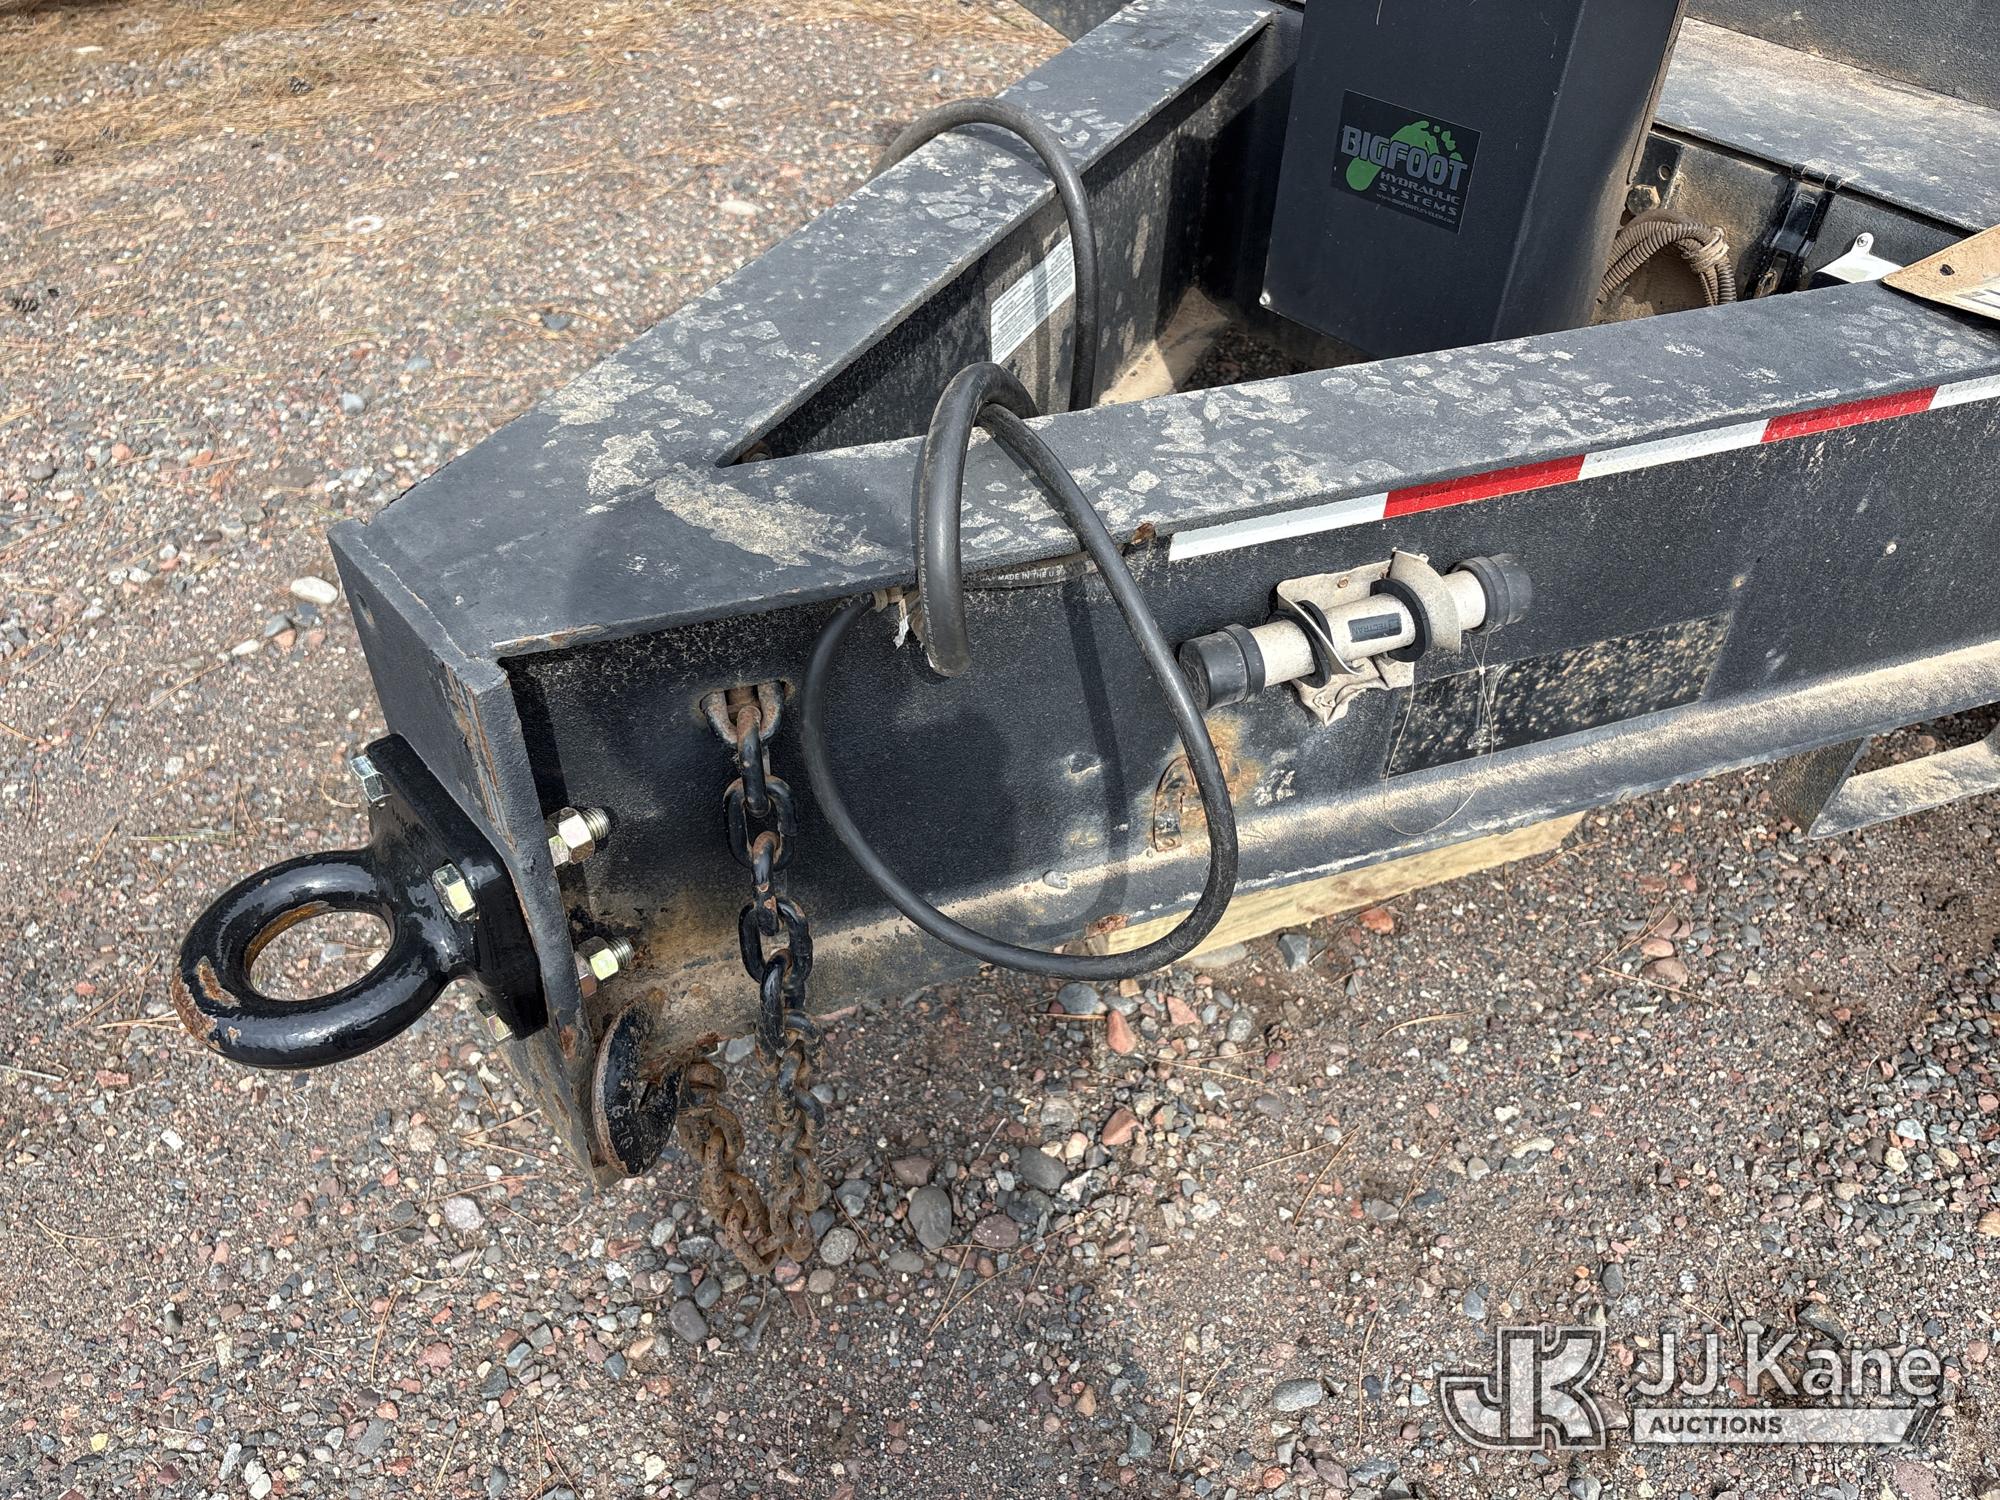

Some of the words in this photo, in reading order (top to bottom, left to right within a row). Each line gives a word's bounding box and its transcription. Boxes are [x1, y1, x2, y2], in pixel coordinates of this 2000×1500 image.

[1340, 125, 1468, 191] BIGFOOT
[1378, 182, 1459, 217] SYSTEMS
[1380, 171, 1462, 206] HYDRAULIC
[998, 573, 1020, 581] MADE
[1022, 571, 1030, 580] IN
[1033, 570, 1047, 579] THE
